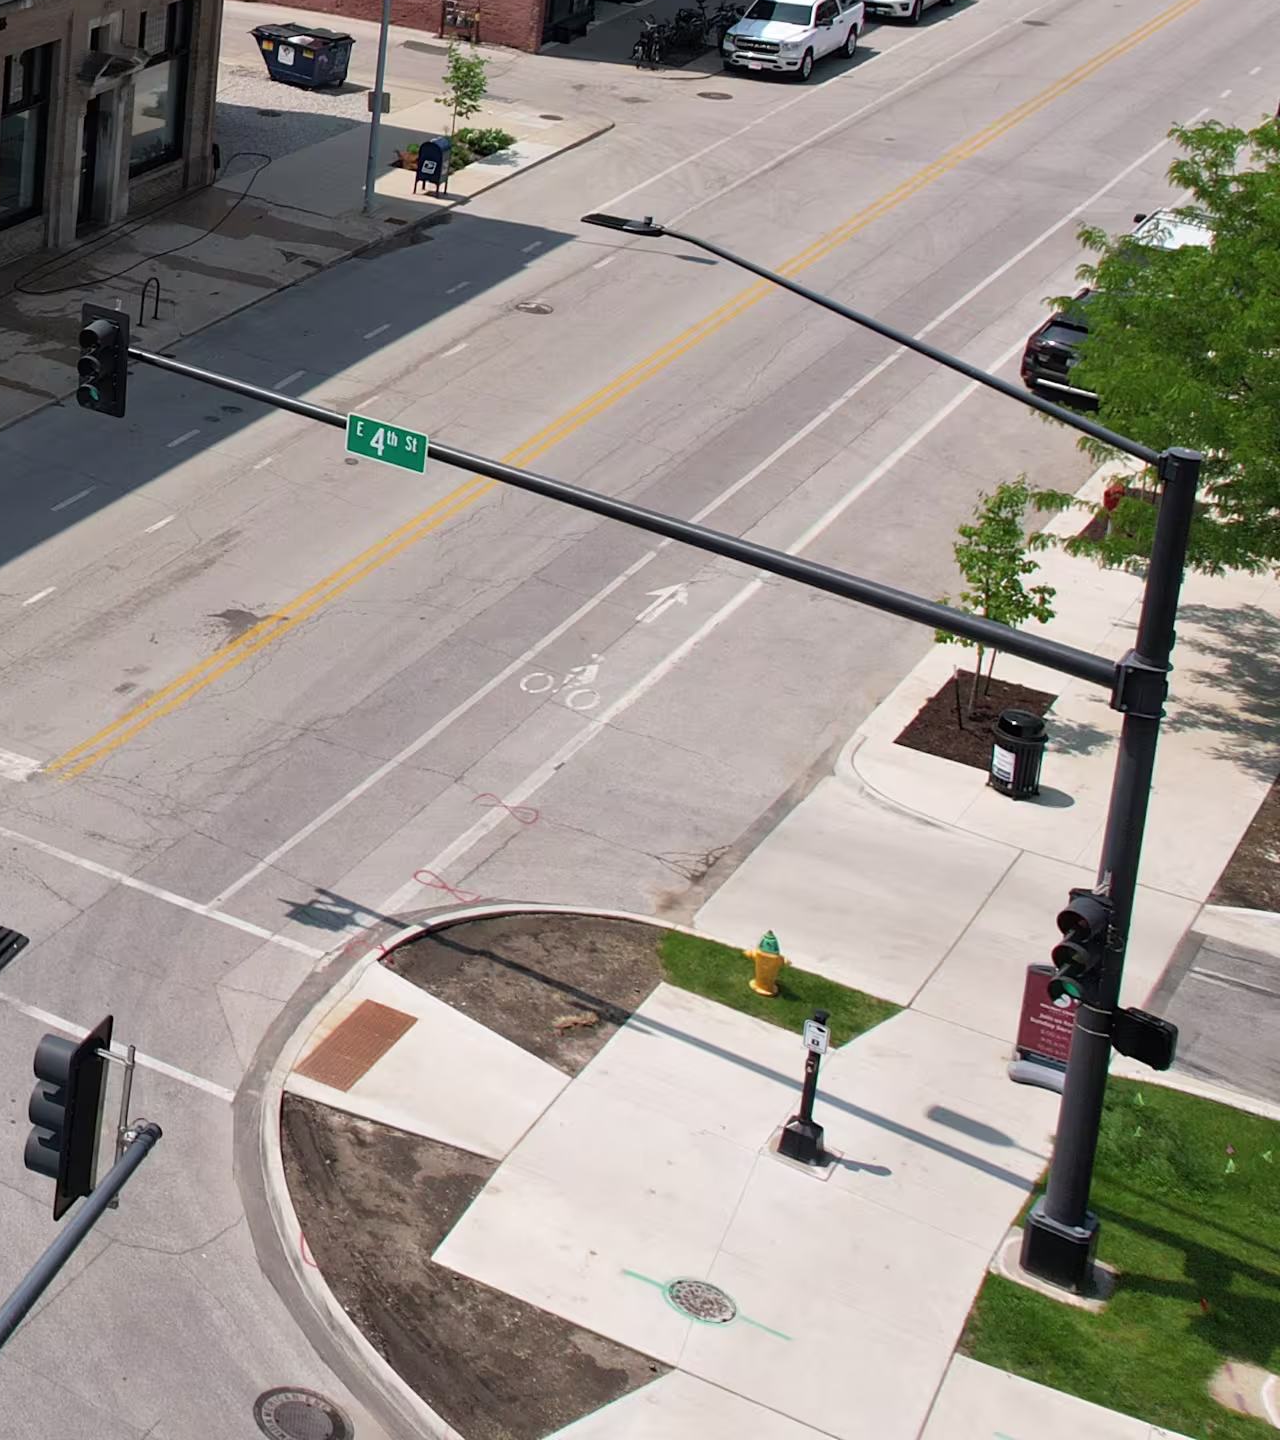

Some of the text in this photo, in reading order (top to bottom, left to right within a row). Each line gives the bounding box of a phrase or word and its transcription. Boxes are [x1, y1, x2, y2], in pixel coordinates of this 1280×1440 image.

[356, 421, 418, 456] E 4th St
